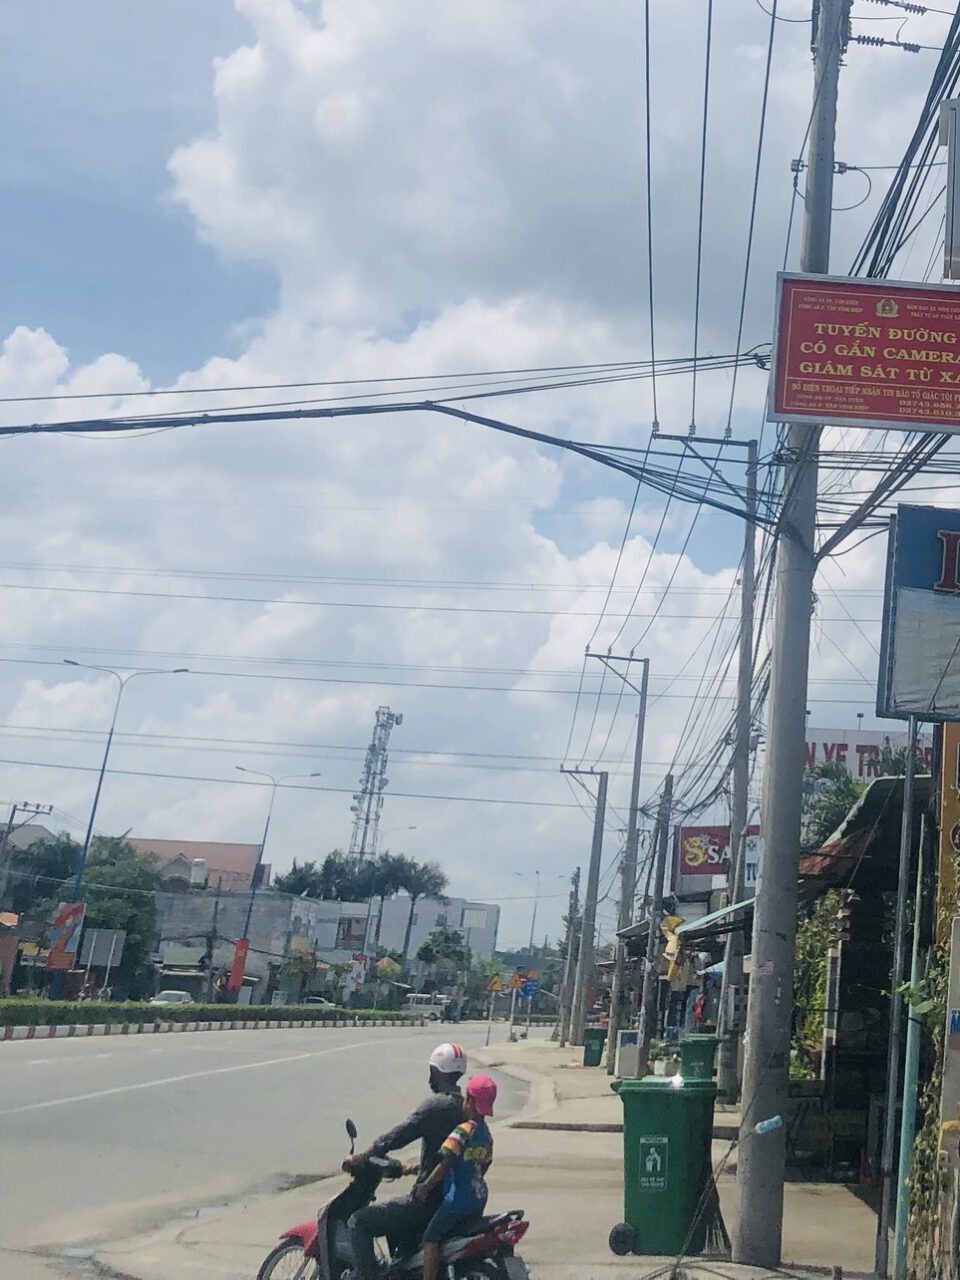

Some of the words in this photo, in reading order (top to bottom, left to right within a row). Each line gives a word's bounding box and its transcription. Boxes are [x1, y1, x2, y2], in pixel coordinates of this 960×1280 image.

[814, 321, 881, 339] TUYẾN
[888, 327, 957, 344] ĐƯỜNG
[800, 340, 827, 354] CÓ
[834, 340, 876, 358] GẮN
[800, 360, 853, 376] GIÁM
[860, 364, 899, 379] SÁT
[906, 367, 933, 381] TỪ
